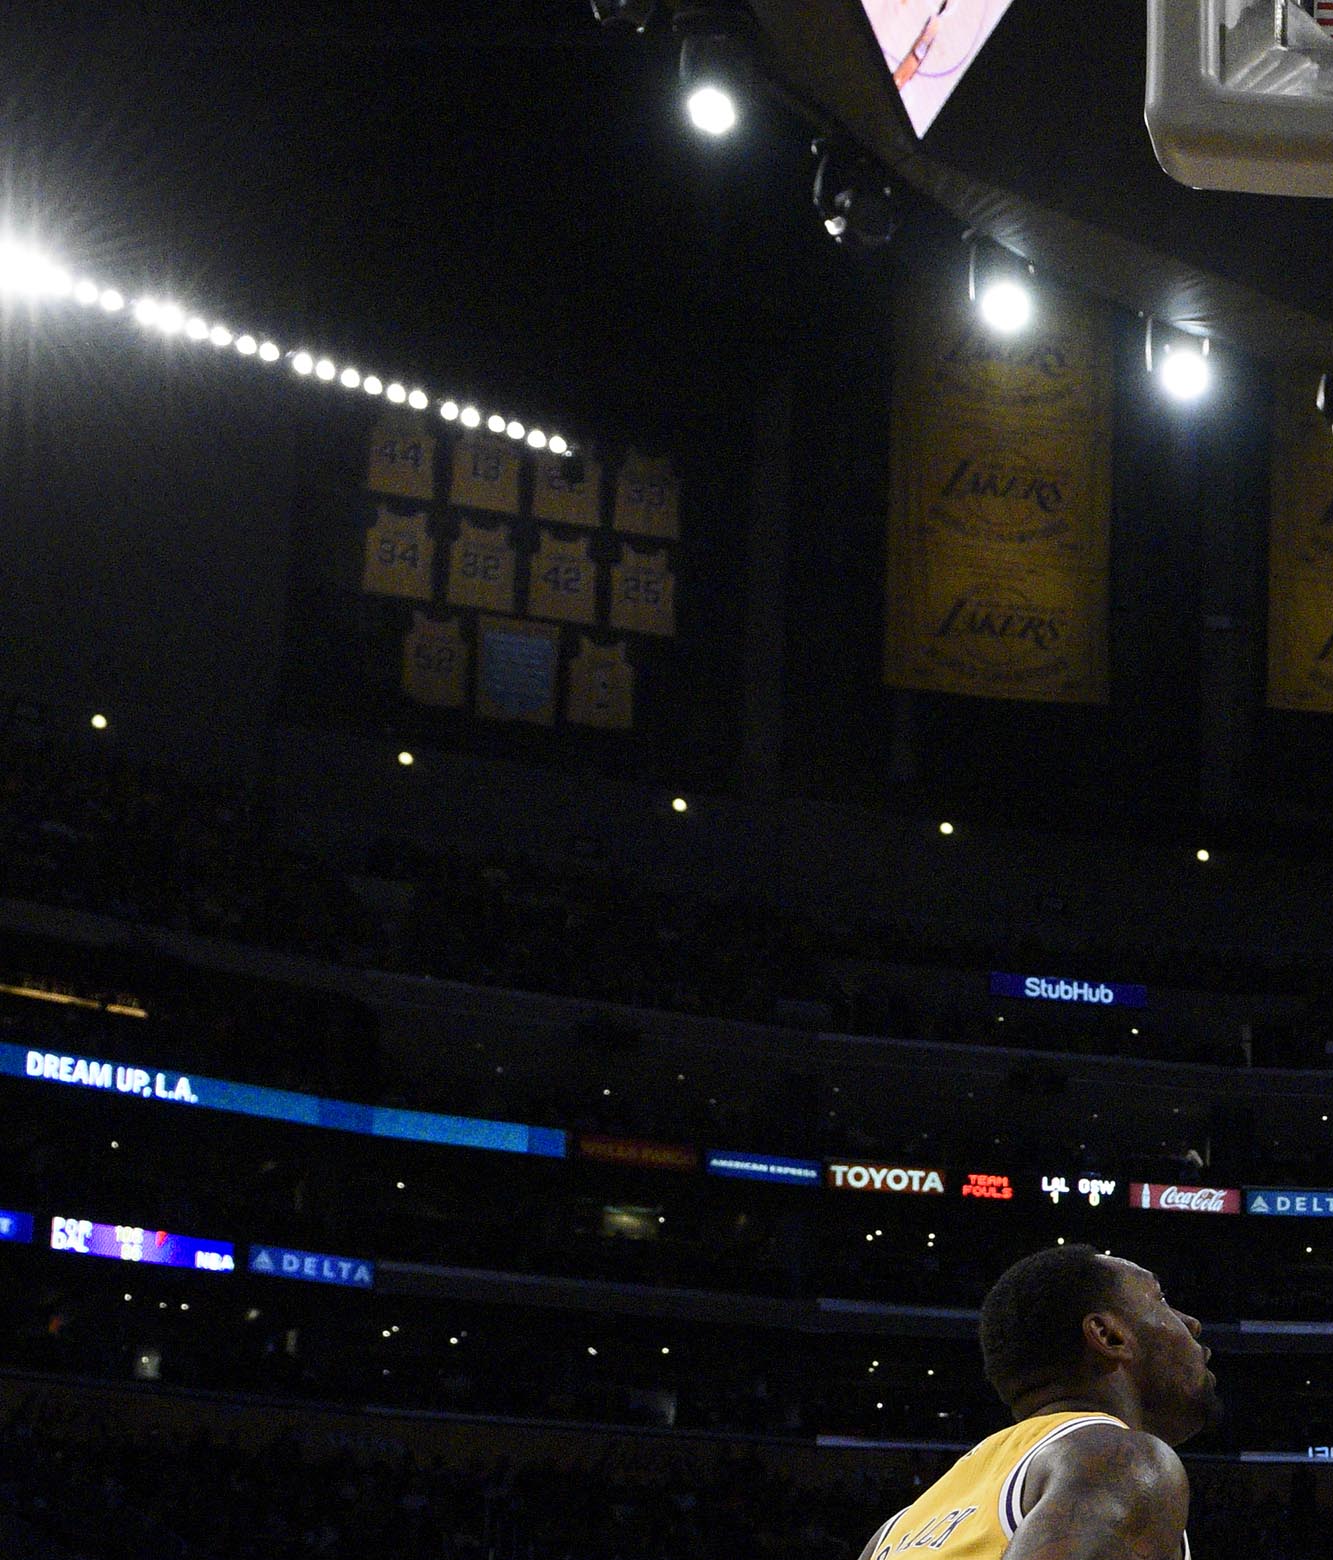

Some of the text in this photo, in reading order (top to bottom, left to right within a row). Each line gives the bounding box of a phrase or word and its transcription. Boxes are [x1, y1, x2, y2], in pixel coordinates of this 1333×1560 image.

[1023, 976, 1114, 1004] StubHub
[26, 1050, 199, 1103] DREAM UP, L.A.
[829, 1164, 945, 1194] TOYOTA
[962, 1184, 1013, 1200] FOULS
[967, 1173, 1009, 1187] TEAM
[281, 1253, 371, 1283] DELTA
